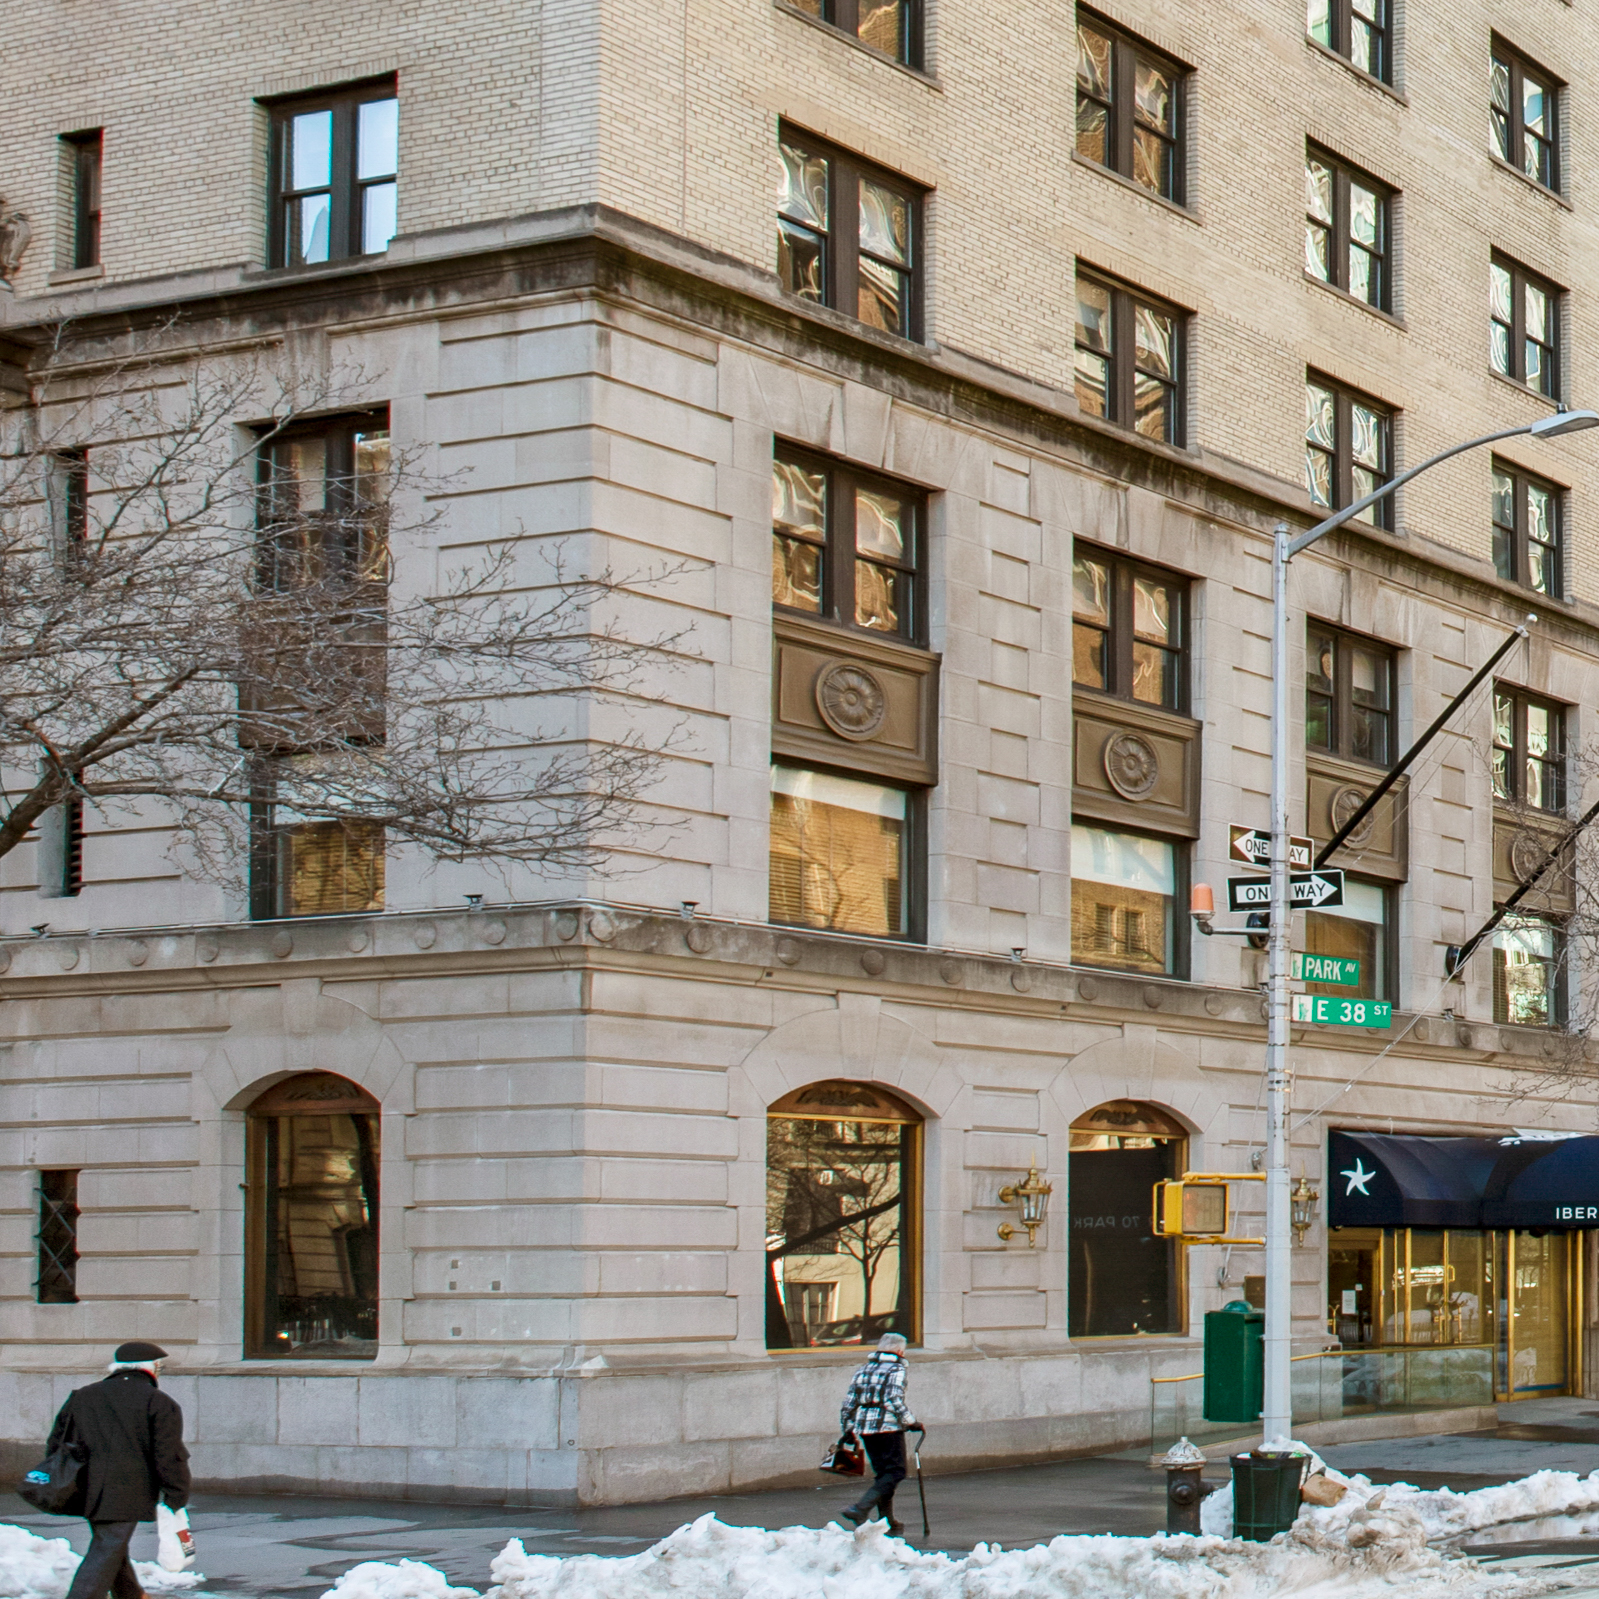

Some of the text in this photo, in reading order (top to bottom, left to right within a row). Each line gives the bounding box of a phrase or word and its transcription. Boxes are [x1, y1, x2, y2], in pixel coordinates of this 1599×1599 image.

[1245, 839, 1304, 862] ONE AY
[1246, 883, 1326, 901] ON WAY
[1305, 957, 1356, 981] PARK AV
[1316, 1000, 1389, 1023] E 38 ST
